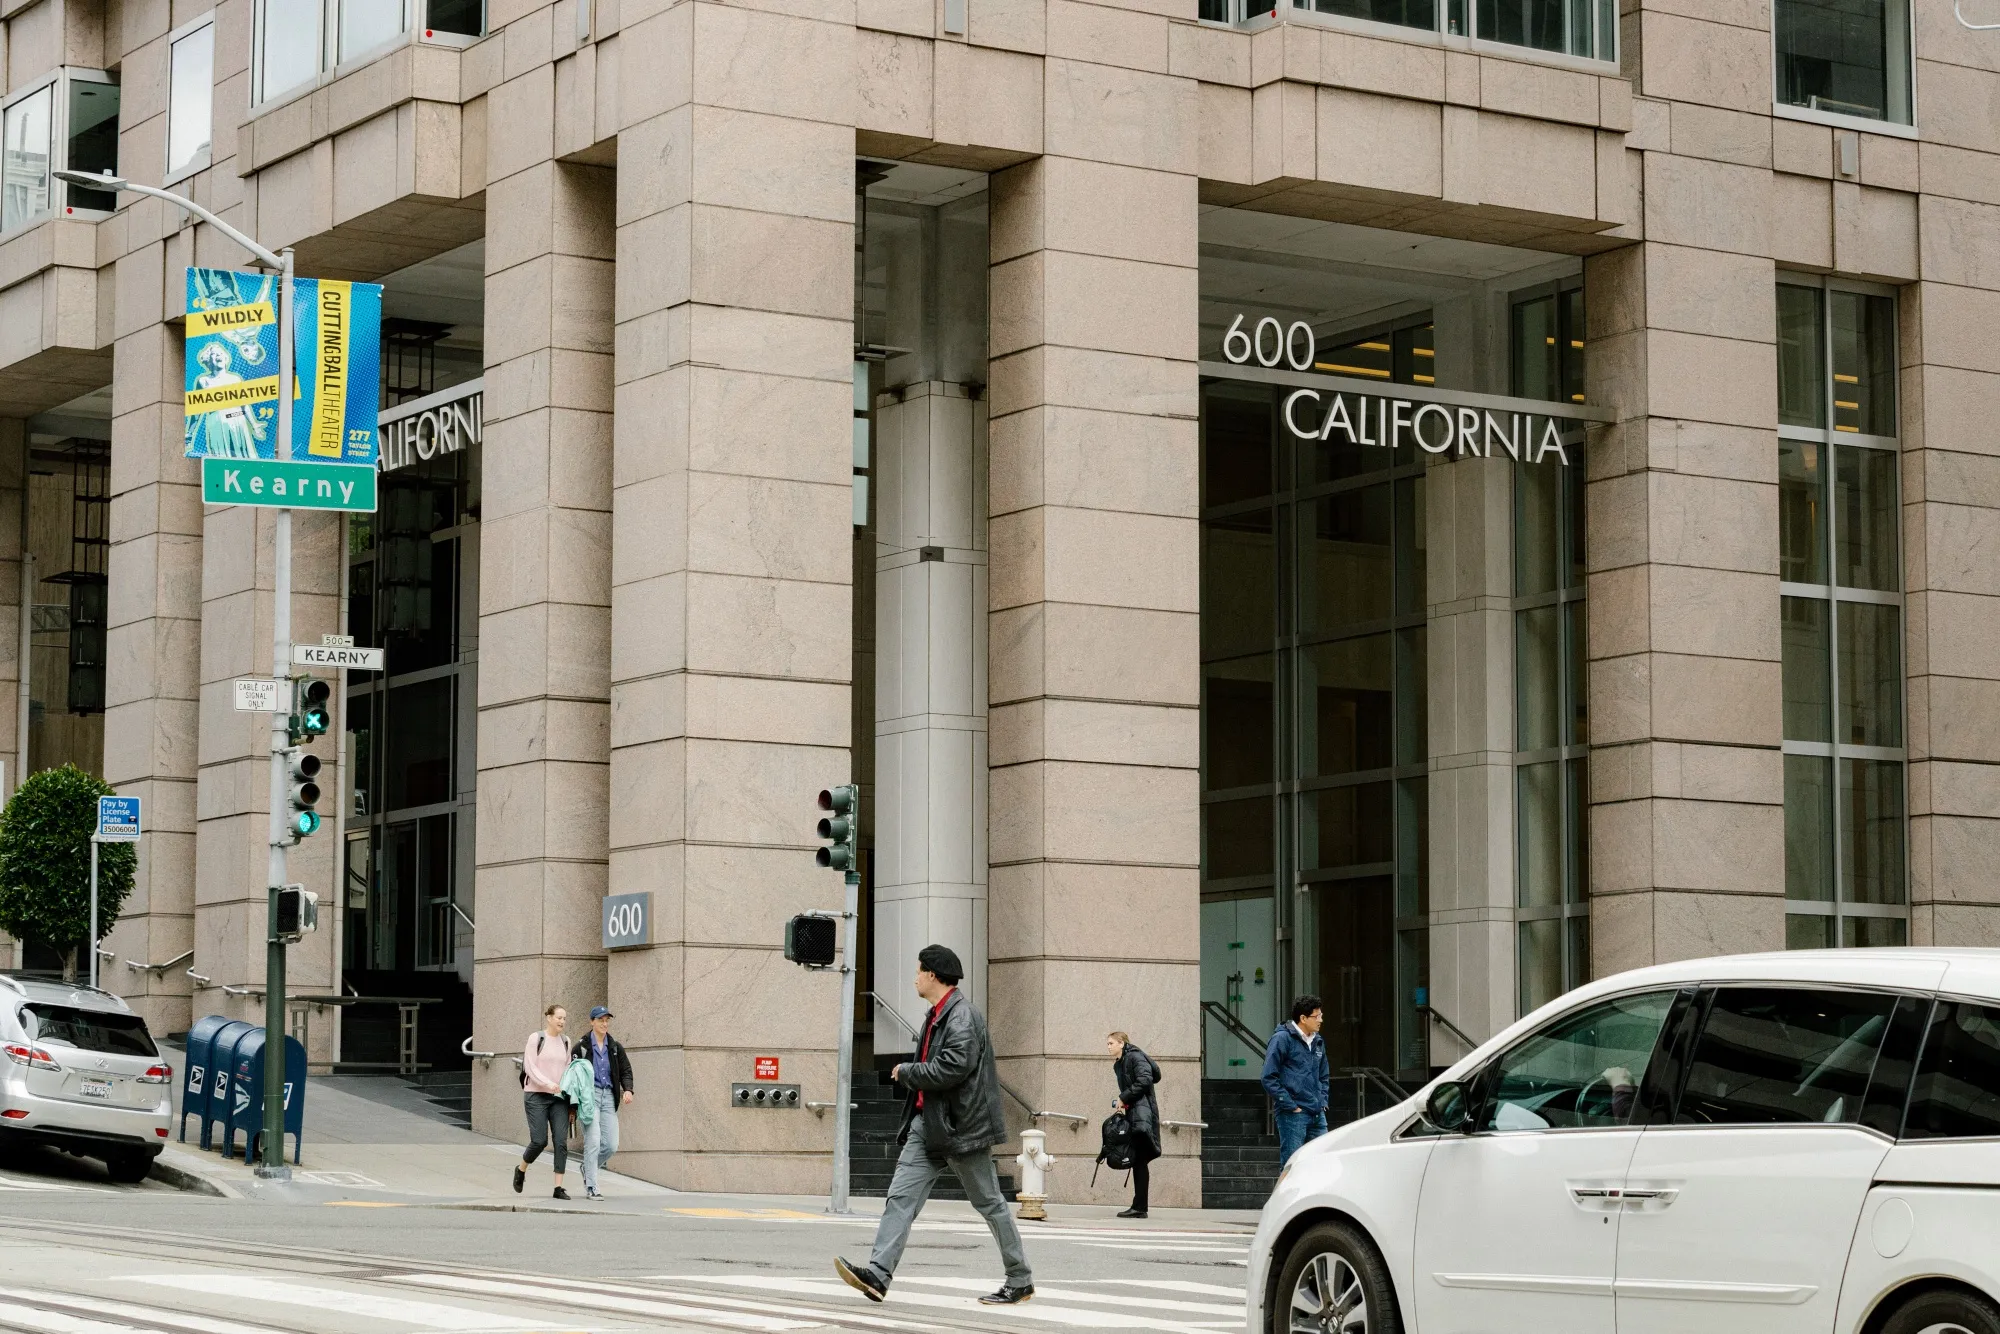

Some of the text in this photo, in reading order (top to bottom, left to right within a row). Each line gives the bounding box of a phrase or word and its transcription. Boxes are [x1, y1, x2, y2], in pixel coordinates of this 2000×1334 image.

[203, 309, 264, 327] WILDLY
[1223, 313, 1315, 371] 600
[188, 385, 277, 405] IMAGINATIVE
[349, 429, 371, 441] 277
[1284, 389, 1569, 466] CALIFORNIA
[224, 469, 355, 504] Kearny
[325, 636, 343, 645] 500
[305, 649, 369, 664] KEARNY
[239, 683, 274, 692] CABLE CAR
[245, 691, 267, 699] SIGNAL
[248, 700, 264, 708] ONLY
[102, 800, 128, 809] Pay by
[608, 903, 642, 937] 600
